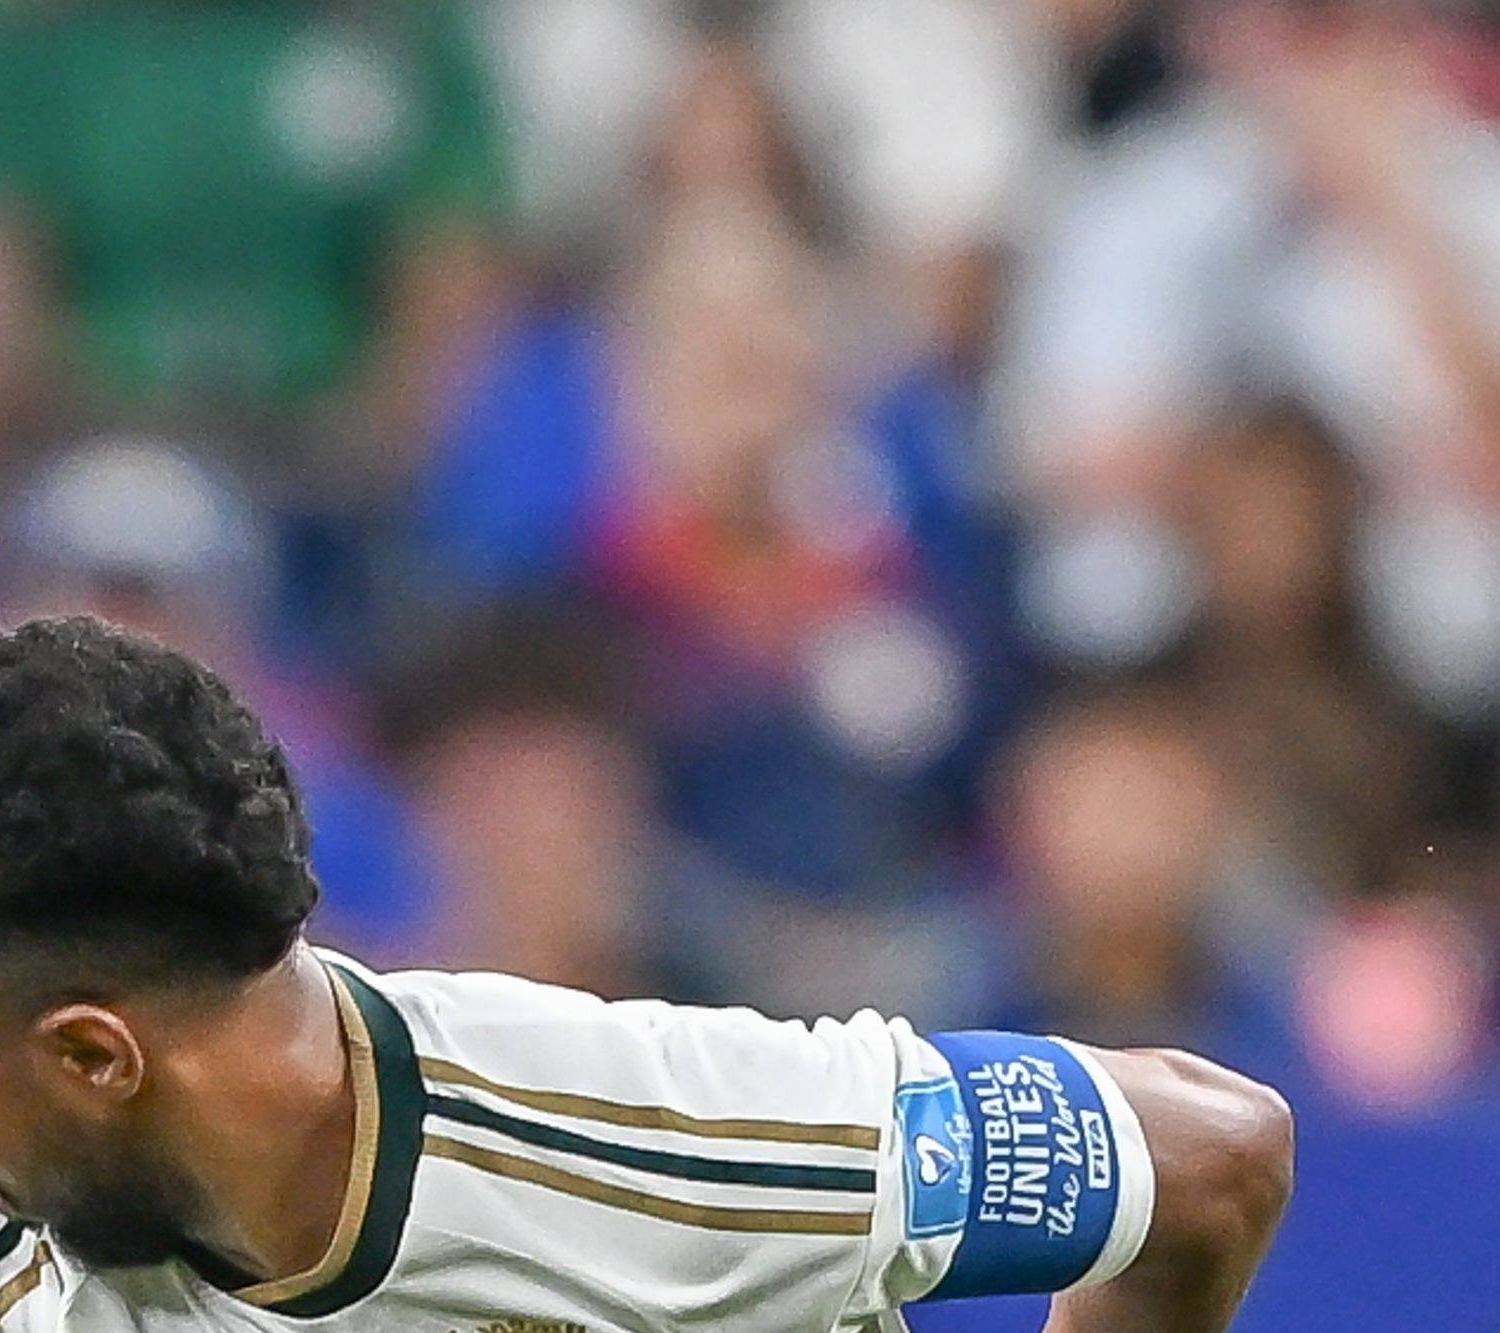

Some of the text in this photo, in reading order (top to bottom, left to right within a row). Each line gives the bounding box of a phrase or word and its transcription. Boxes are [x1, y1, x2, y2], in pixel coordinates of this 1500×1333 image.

[967, 1060, 1012, 1223] FOOTBALL
[993, 1061, 1051, 1226] UNITES
[1018, 1053, 1084, 1240] the World
[1088, 1117, 1108, 1182] FIFA
